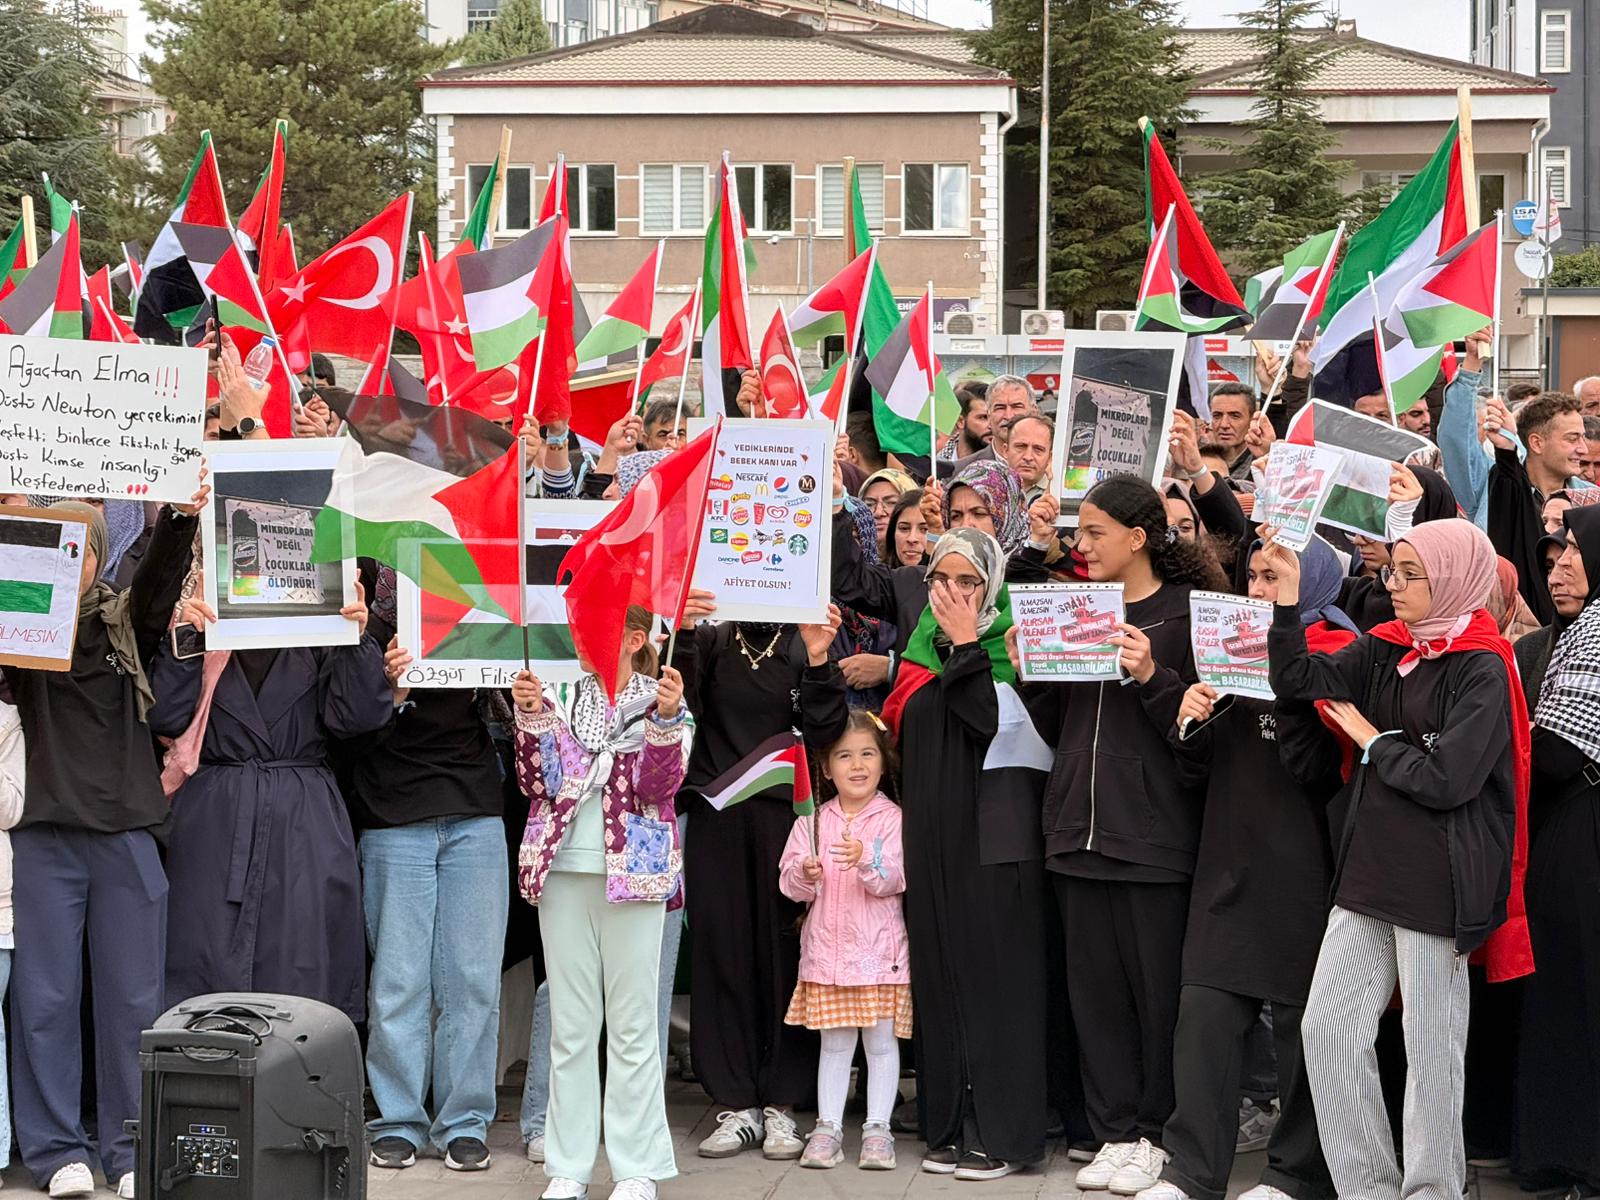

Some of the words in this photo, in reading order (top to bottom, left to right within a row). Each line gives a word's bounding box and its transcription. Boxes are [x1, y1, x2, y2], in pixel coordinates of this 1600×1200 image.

[8, 344, 82, 388] Ağaçtan
[41, 391, 117, 420] Newton
[1100, 408, 1148, 426] MİKROPLARI
[55, 426, 111, 447] binlerce
[1111, 427, 1134, 441] DEĞİL
[734, 443, 795, 454] YEDİKLERİNDE
[730, 457, 757, 465] BEBEK
[758, 458, 779, 466] KANI
[780, 459, 798, 467] VAR
[1097, 449, 1142, 465] ÇOCUKLARI
[736, 472, 768, 482] NESCAFÉ
[260, 524, 313, 536] MİKROPLARI
[276, 539, 302, 551] DEĞİL
[265, 560, 316, 572] ÇOCUKLARI
[268, 575, 316, 589] ÖLDÜRÜR!
[724, 577, 756, 587] AFİYET
[1019, 598, 1053, 607] ALMAZSAN
[1020, 616, 1054, 627] ALIRSAN
[1022, 626, 1057, 637] ÖLENLER
[1025, 638, 1041, 647] VAR
[406, 666, 466, 685] Özgür
[481, 667, 540, 685] Filis
